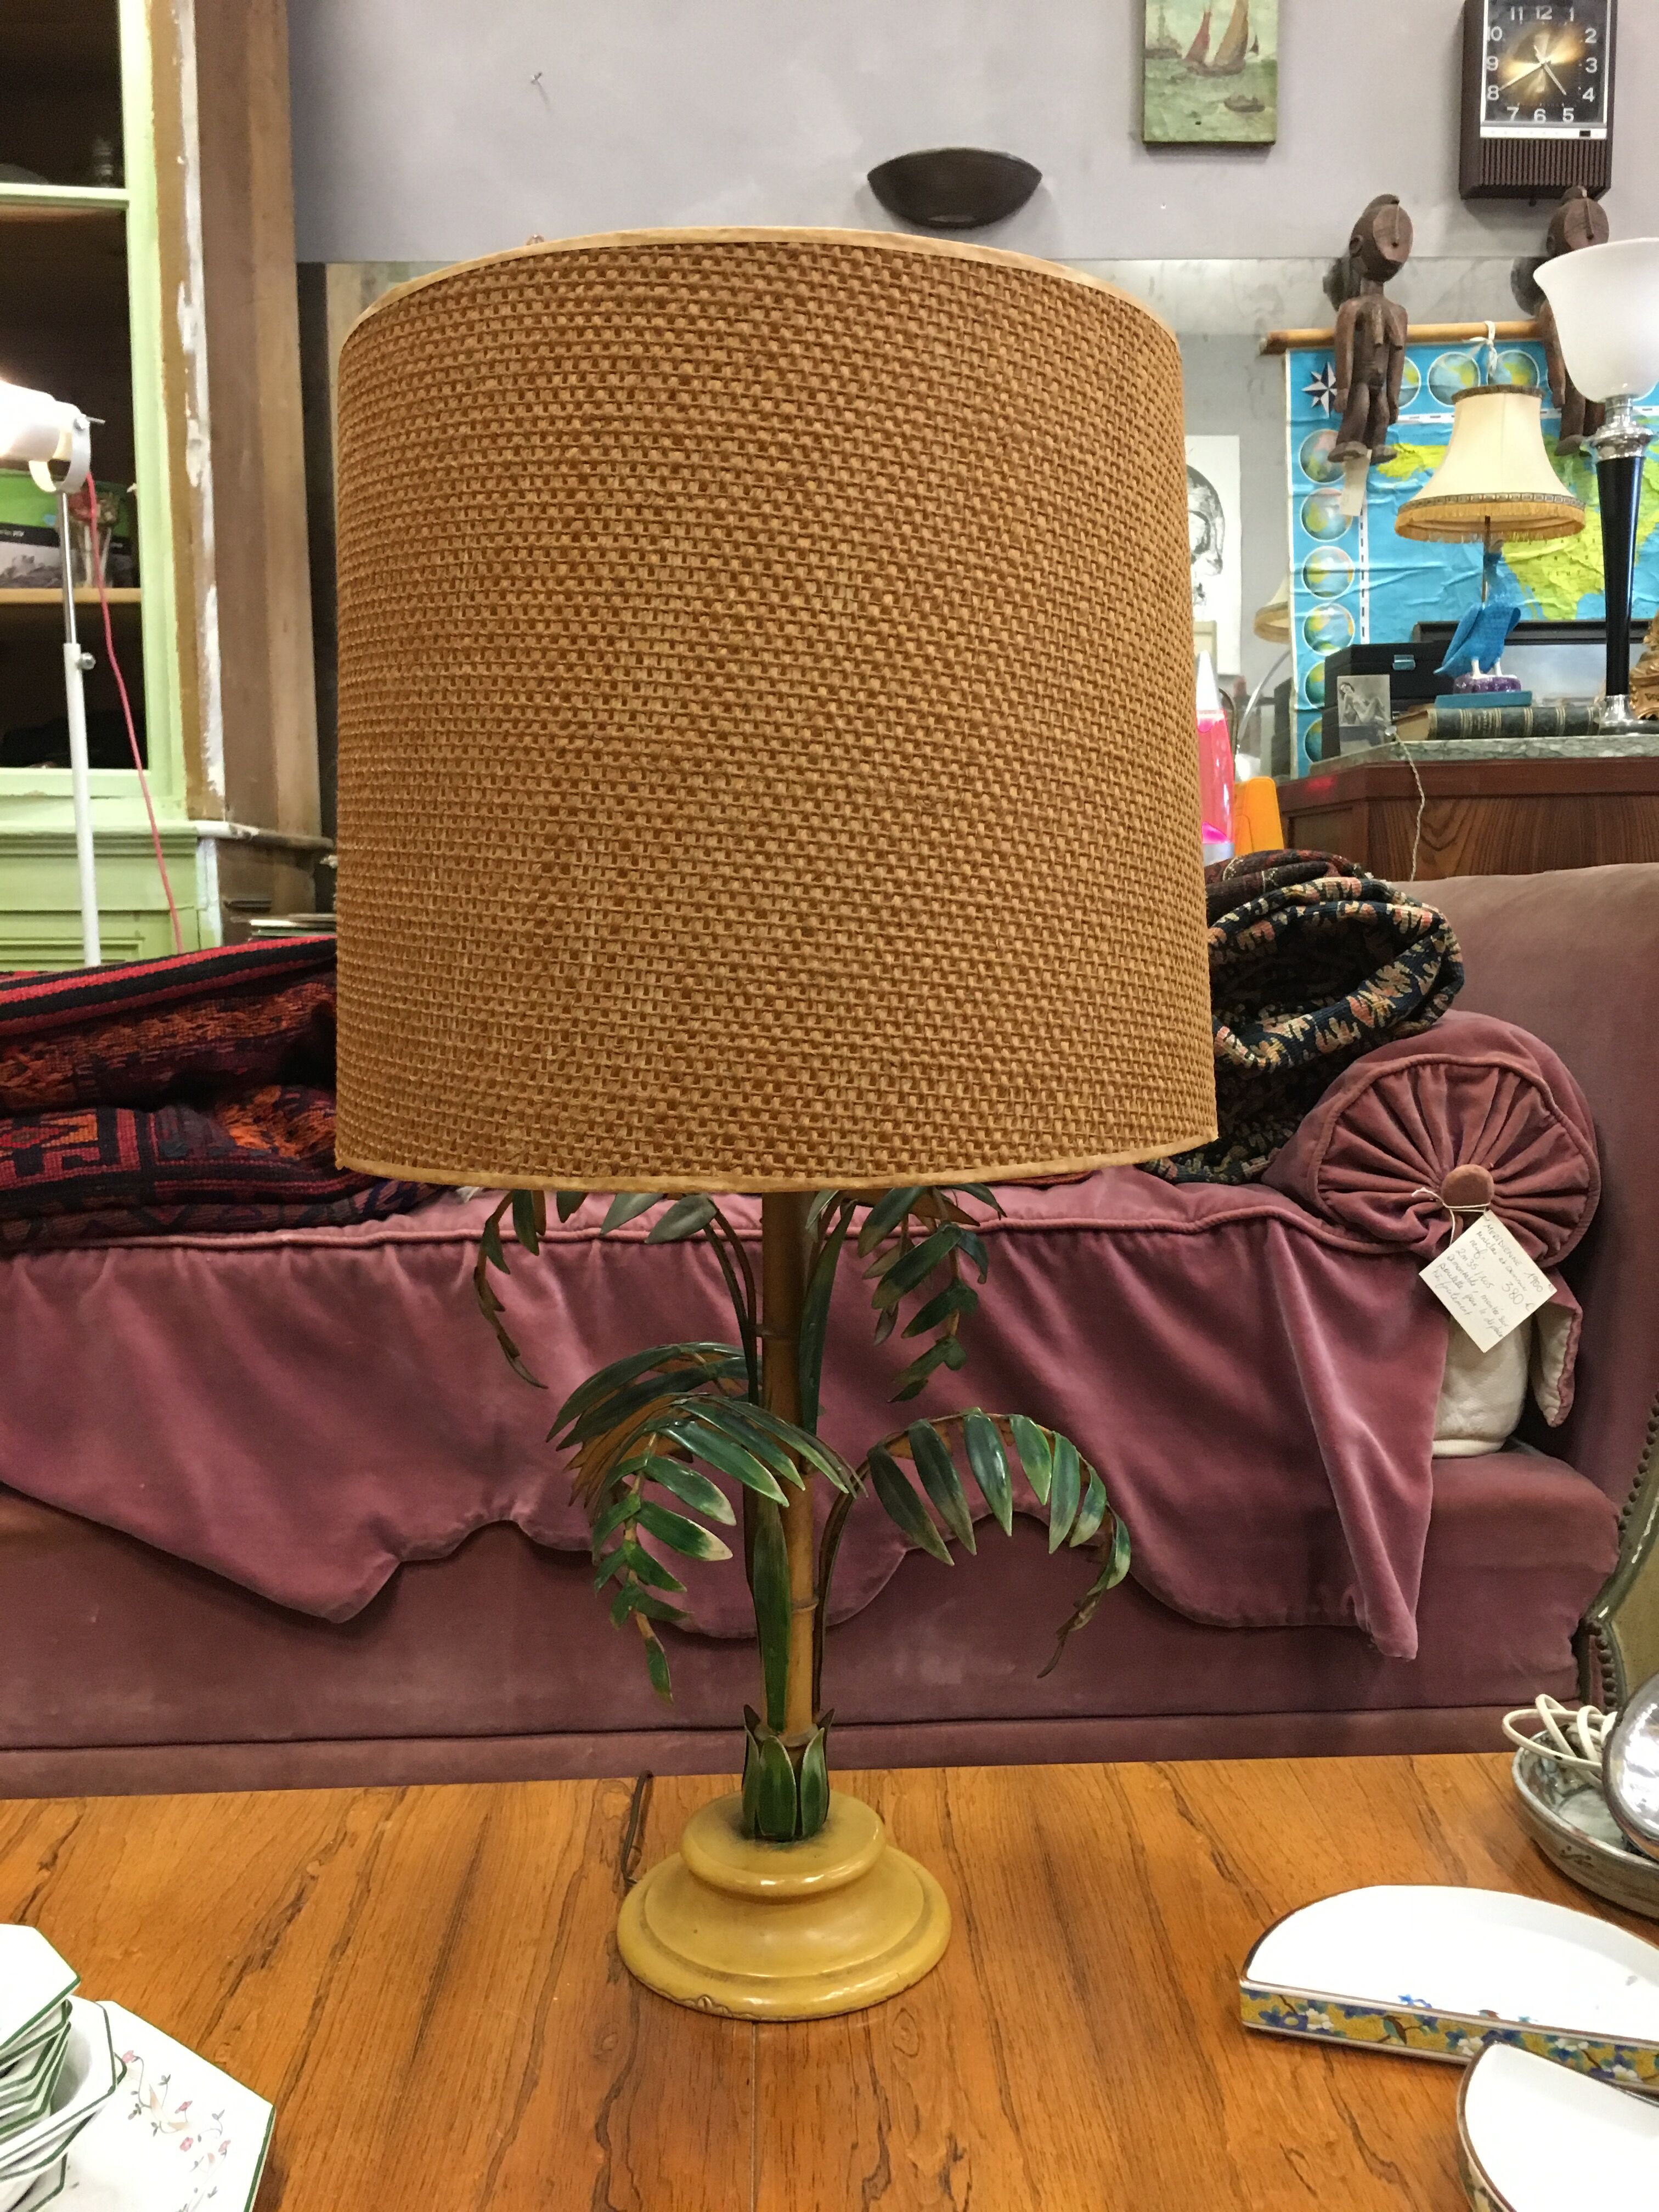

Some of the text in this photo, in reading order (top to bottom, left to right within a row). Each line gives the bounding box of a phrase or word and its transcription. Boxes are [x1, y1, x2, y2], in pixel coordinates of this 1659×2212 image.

[1509, 5, 1574, 20] 11 12 1
[1487, 26, 1502, 41] 10
[1585, 29, 1596, 43] 2
[1487, 57, 1498, 71] 9
[1585, 58, 1597, 73] 3
[1487, 86, 1499, 100] 8
[1583, 88, 1594, 101] 4
[1507, 107, 1574, 123] 7 6 5
[1502, 1282, 1524, 1305] 380
